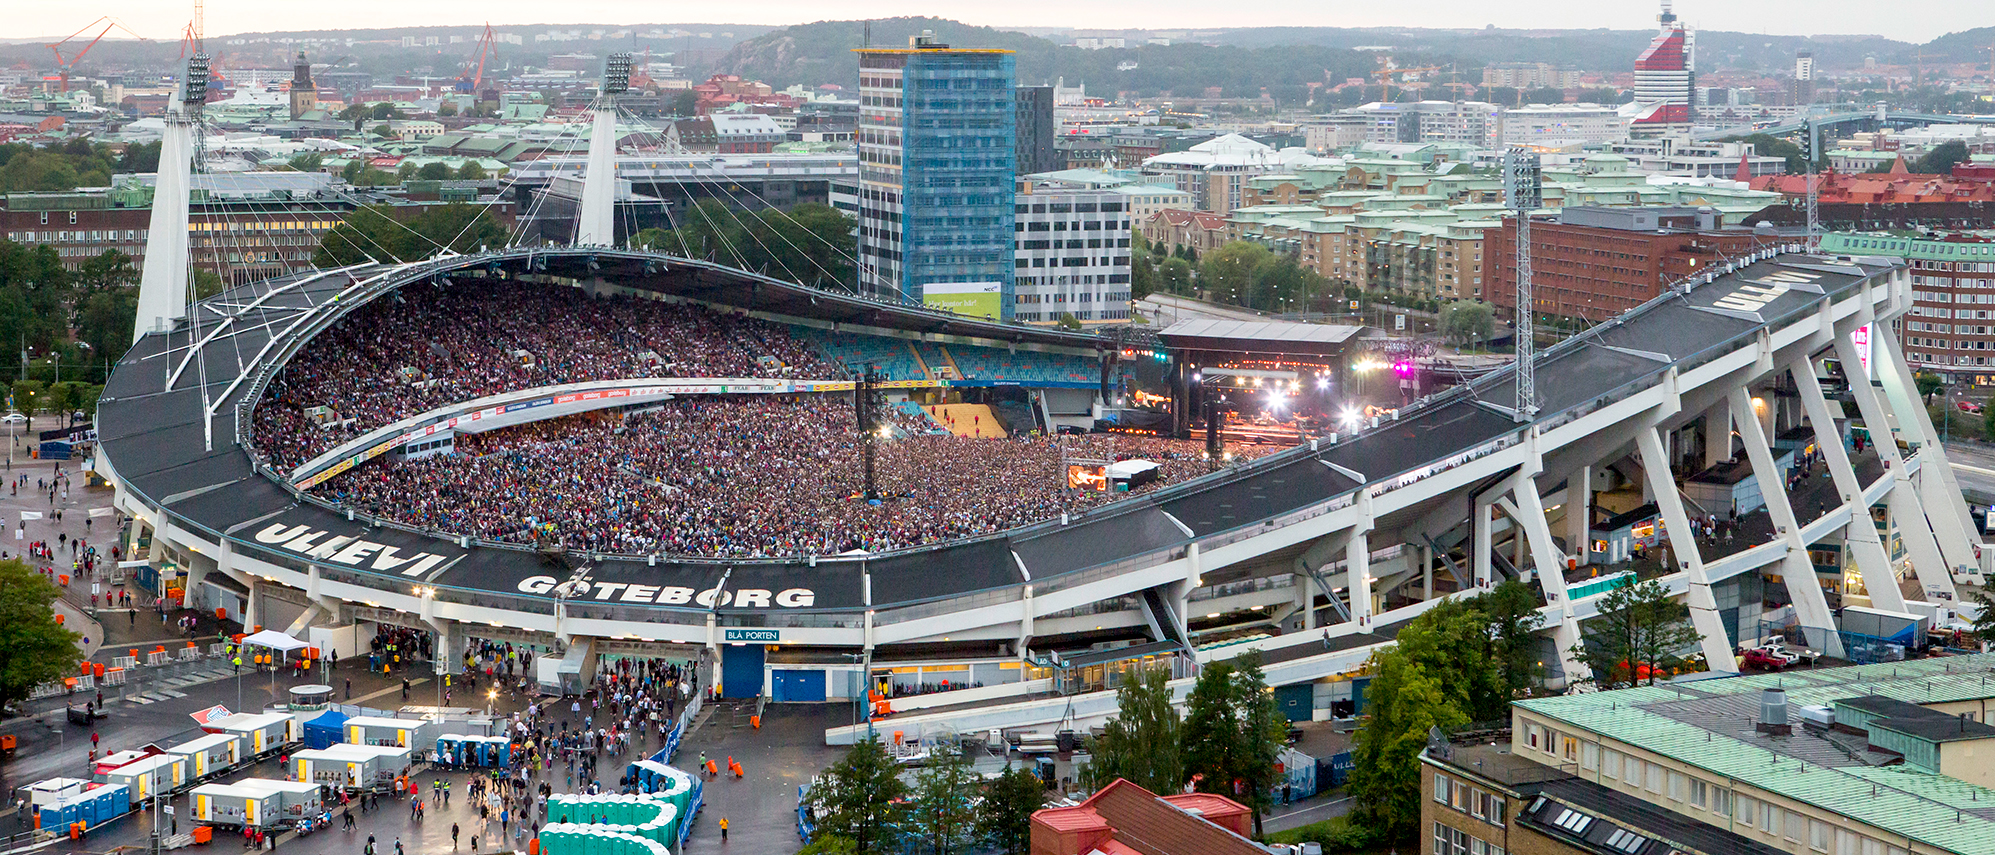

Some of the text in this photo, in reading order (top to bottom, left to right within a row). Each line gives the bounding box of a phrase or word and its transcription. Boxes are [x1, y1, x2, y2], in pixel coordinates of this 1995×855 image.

[255, 522, 447, 577] ULLEVI
[517, 575, 815, 608] GÖTEBORG
[728, 630, 777, 640] BLÅ PORTEN
